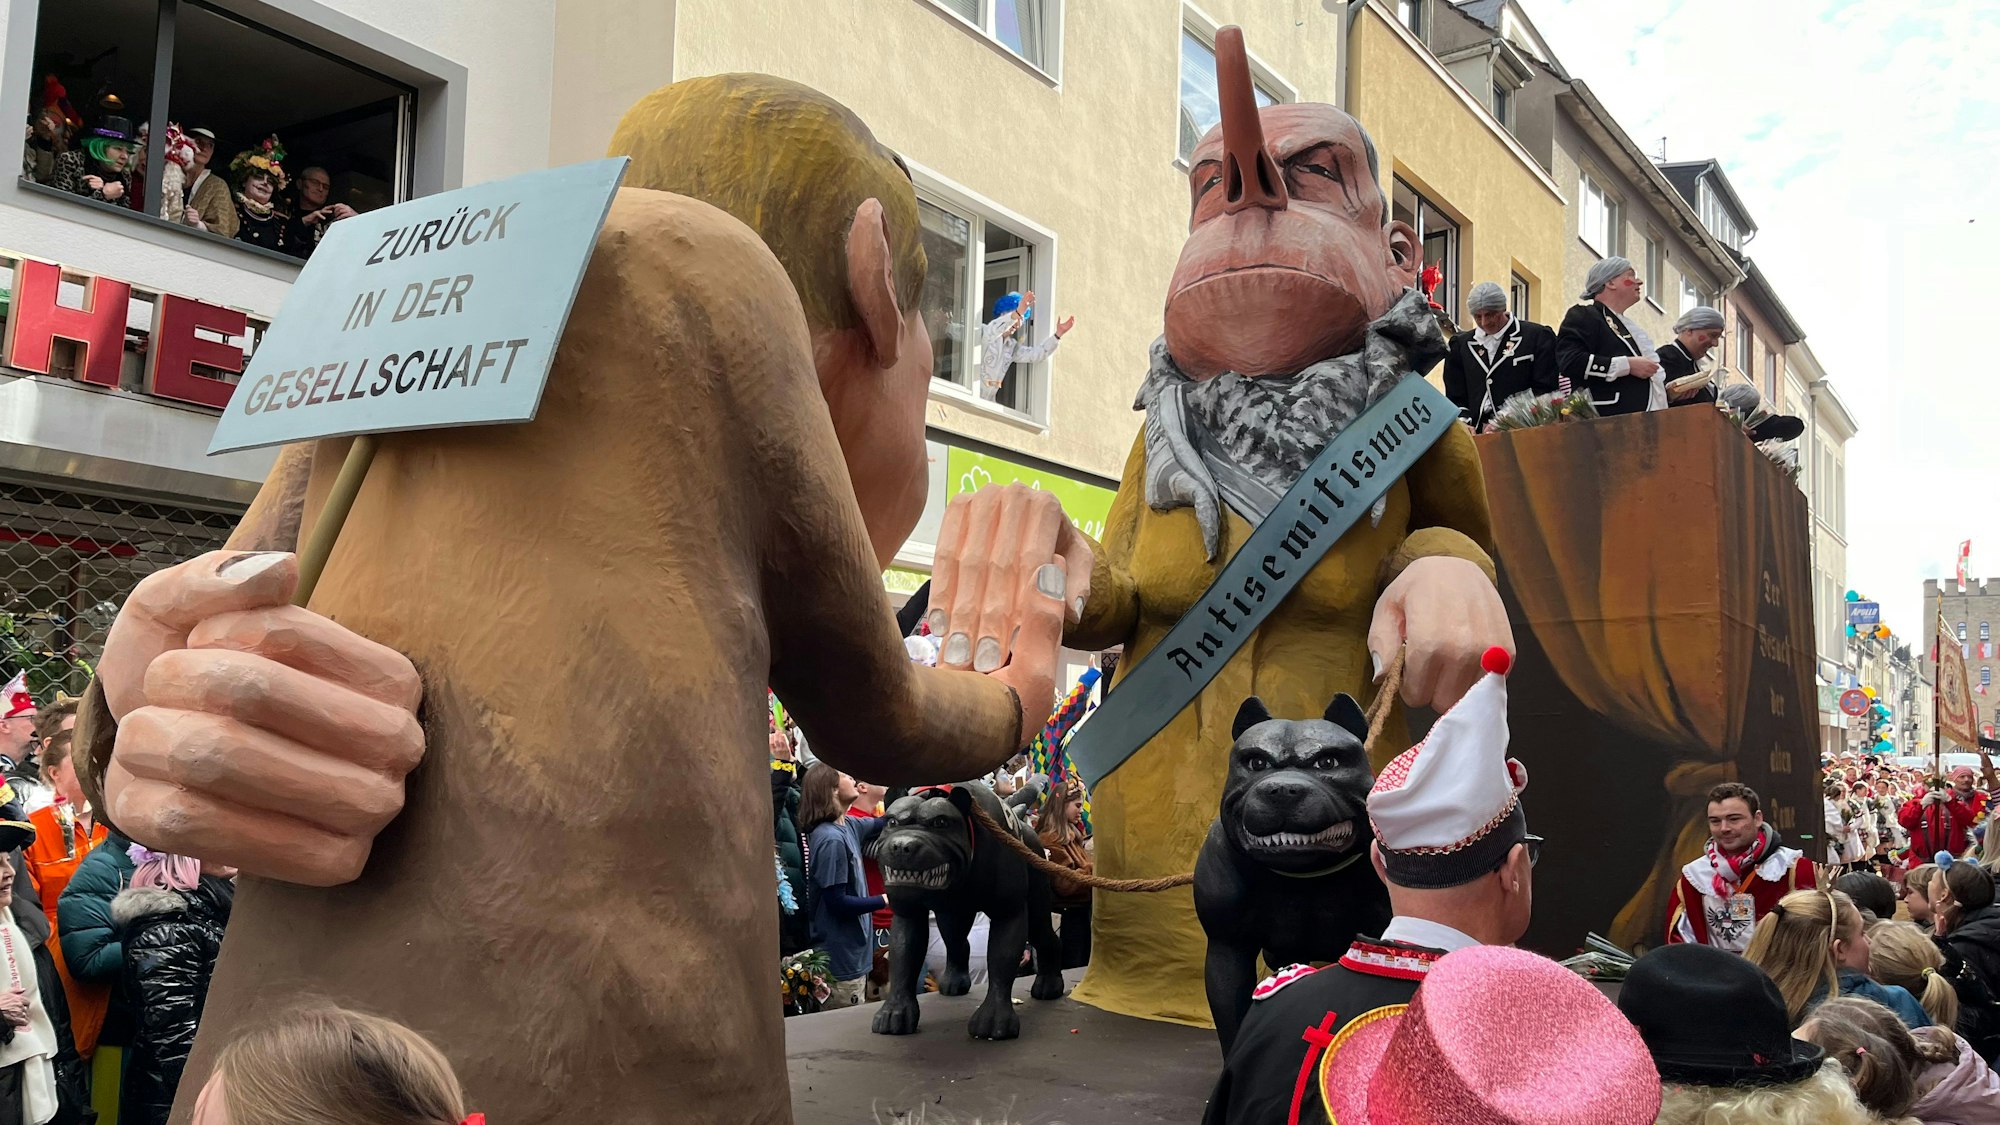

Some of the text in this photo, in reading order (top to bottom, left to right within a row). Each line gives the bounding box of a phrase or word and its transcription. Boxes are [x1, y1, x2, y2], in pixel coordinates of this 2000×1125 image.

[365, 202, 520, 266] ZURÜCK
[341, 274, 474, 332] IN DER
[244, 338, 529, 416] GESELLSCHAFT
[1166, 394, 1433, 682] Antisemitismus
